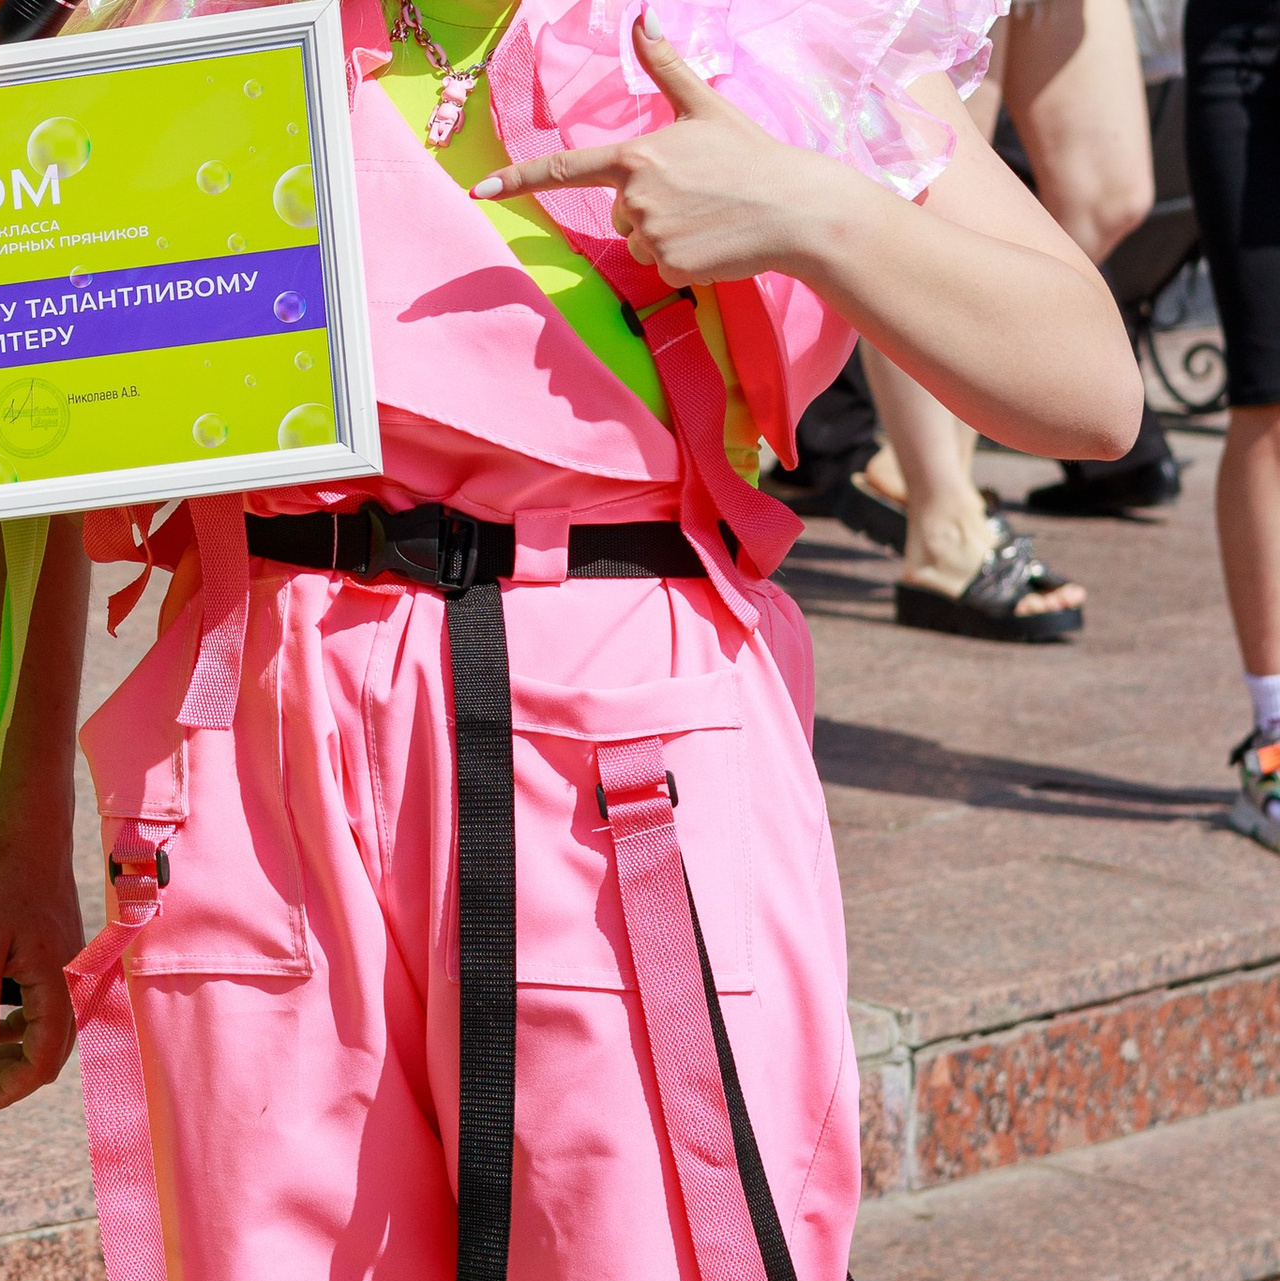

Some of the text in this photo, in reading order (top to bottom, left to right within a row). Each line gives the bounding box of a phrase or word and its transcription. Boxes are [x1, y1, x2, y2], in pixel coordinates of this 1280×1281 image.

[59, 225, 150, 248] ПРЯНИКОВ
[25, 271, 259, 319] ТАЛАНТЛИВОМУ
[67, 385, 141, 405] Николаев А.В.
